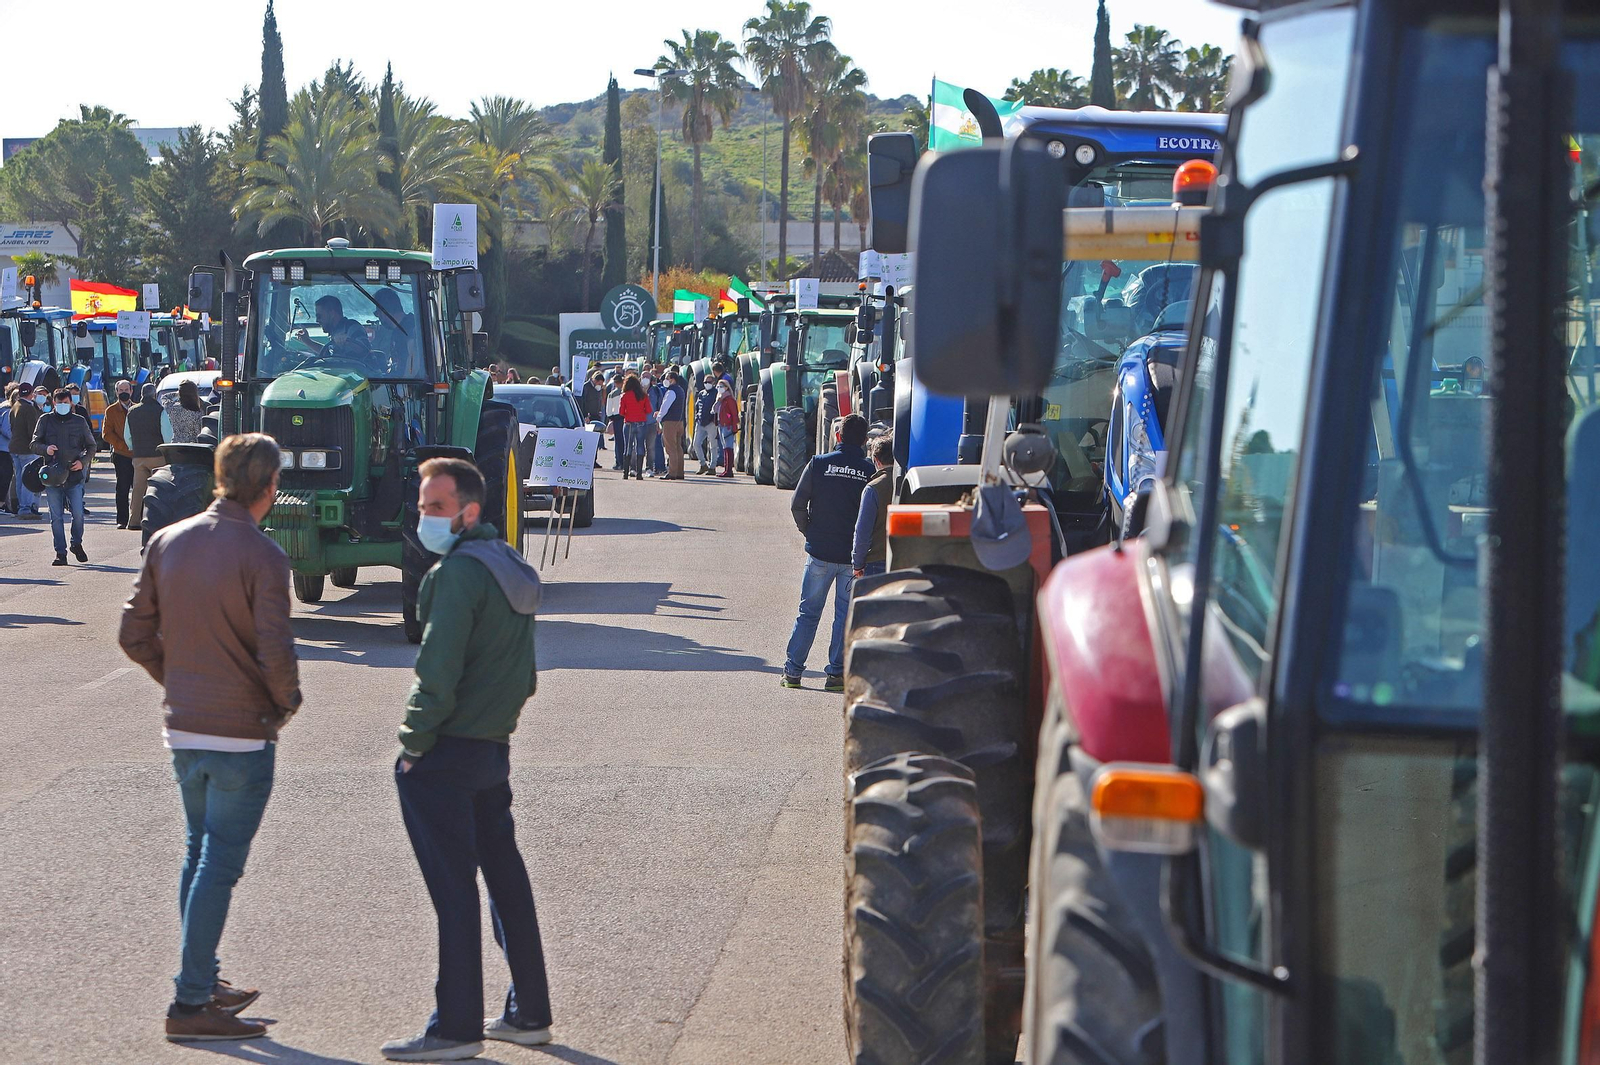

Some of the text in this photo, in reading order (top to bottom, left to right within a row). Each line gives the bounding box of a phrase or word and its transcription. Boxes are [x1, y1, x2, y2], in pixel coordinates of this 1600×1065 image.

[4, 230, 54, 239] JEREZ
[461, 258, 475, 266] Vivo
[575, 340, 613, 350] Barceló
[578, 350, 599, 361] Golf
[602, 351, 611, 361] &
[556, 476, 589, 486] Campo Vivo
